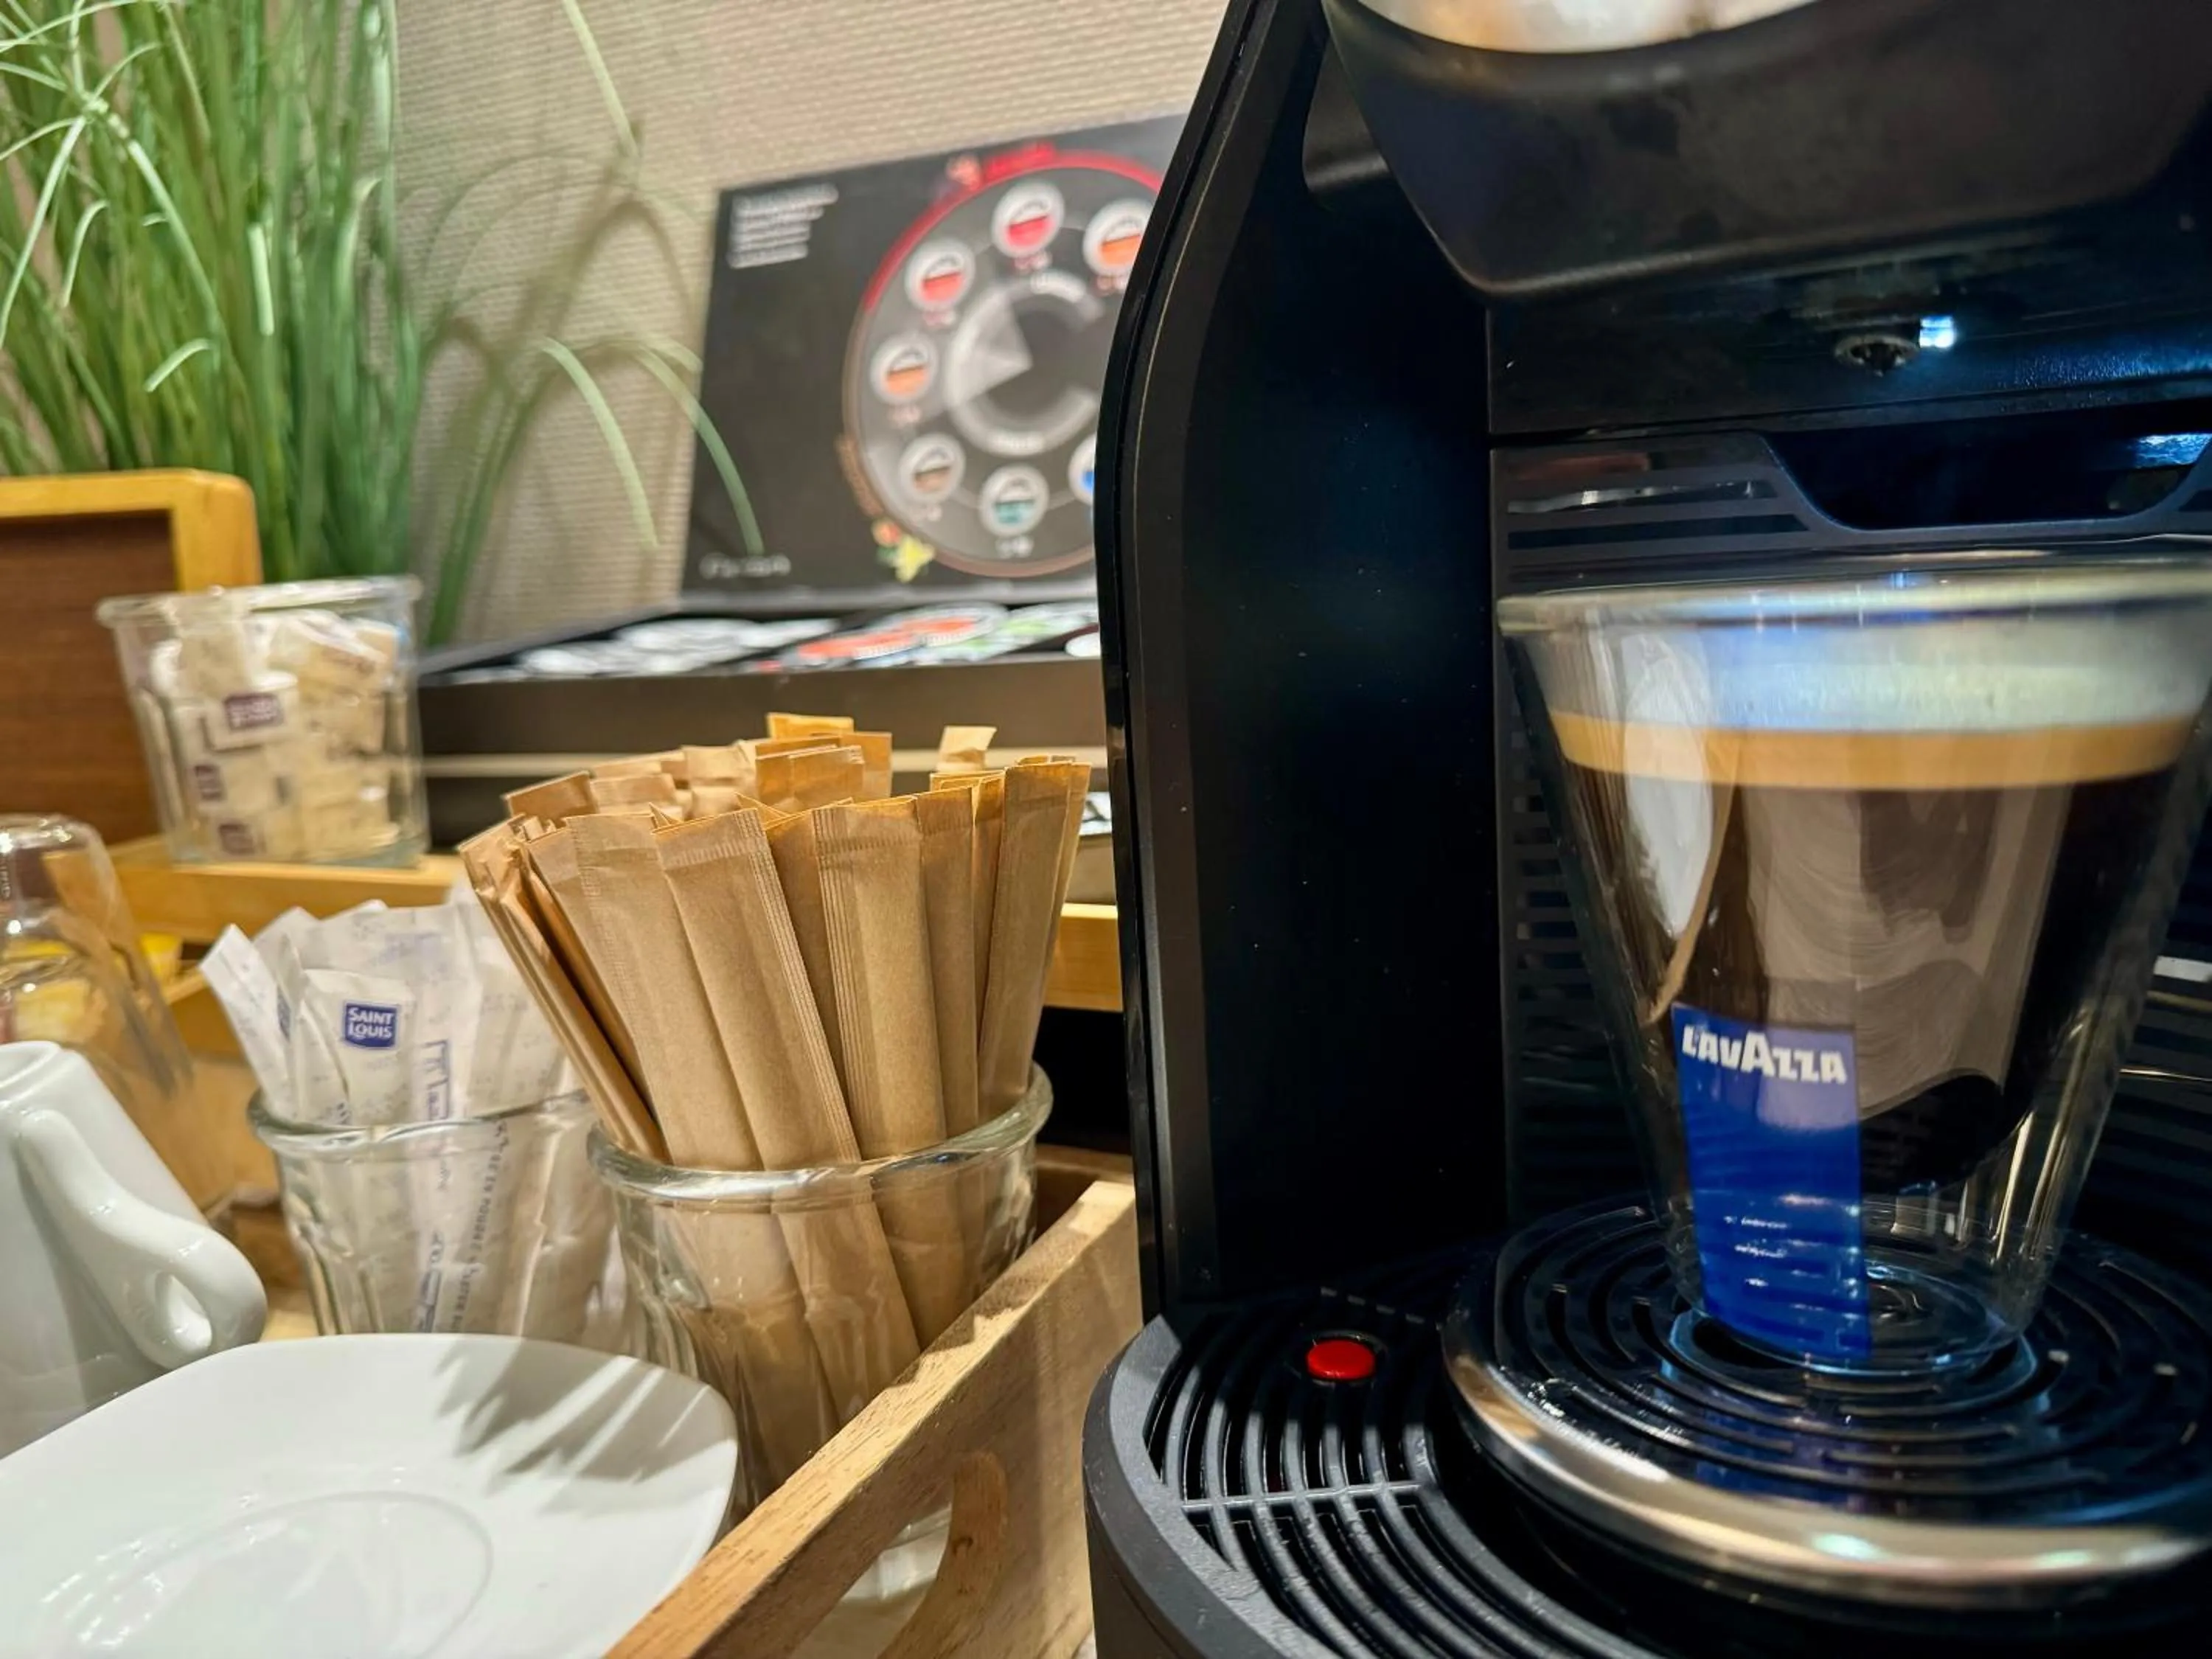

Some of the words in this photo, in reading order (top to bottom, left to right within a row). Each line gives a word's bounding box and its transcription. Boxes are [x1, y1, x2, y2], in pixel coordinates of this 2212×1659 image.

[348, 1007, 394, 1025] SAINT
[347, 1023, 392, 1039] LOUIS
[1682, 1024, 1847, 1084] LAVAZZA
